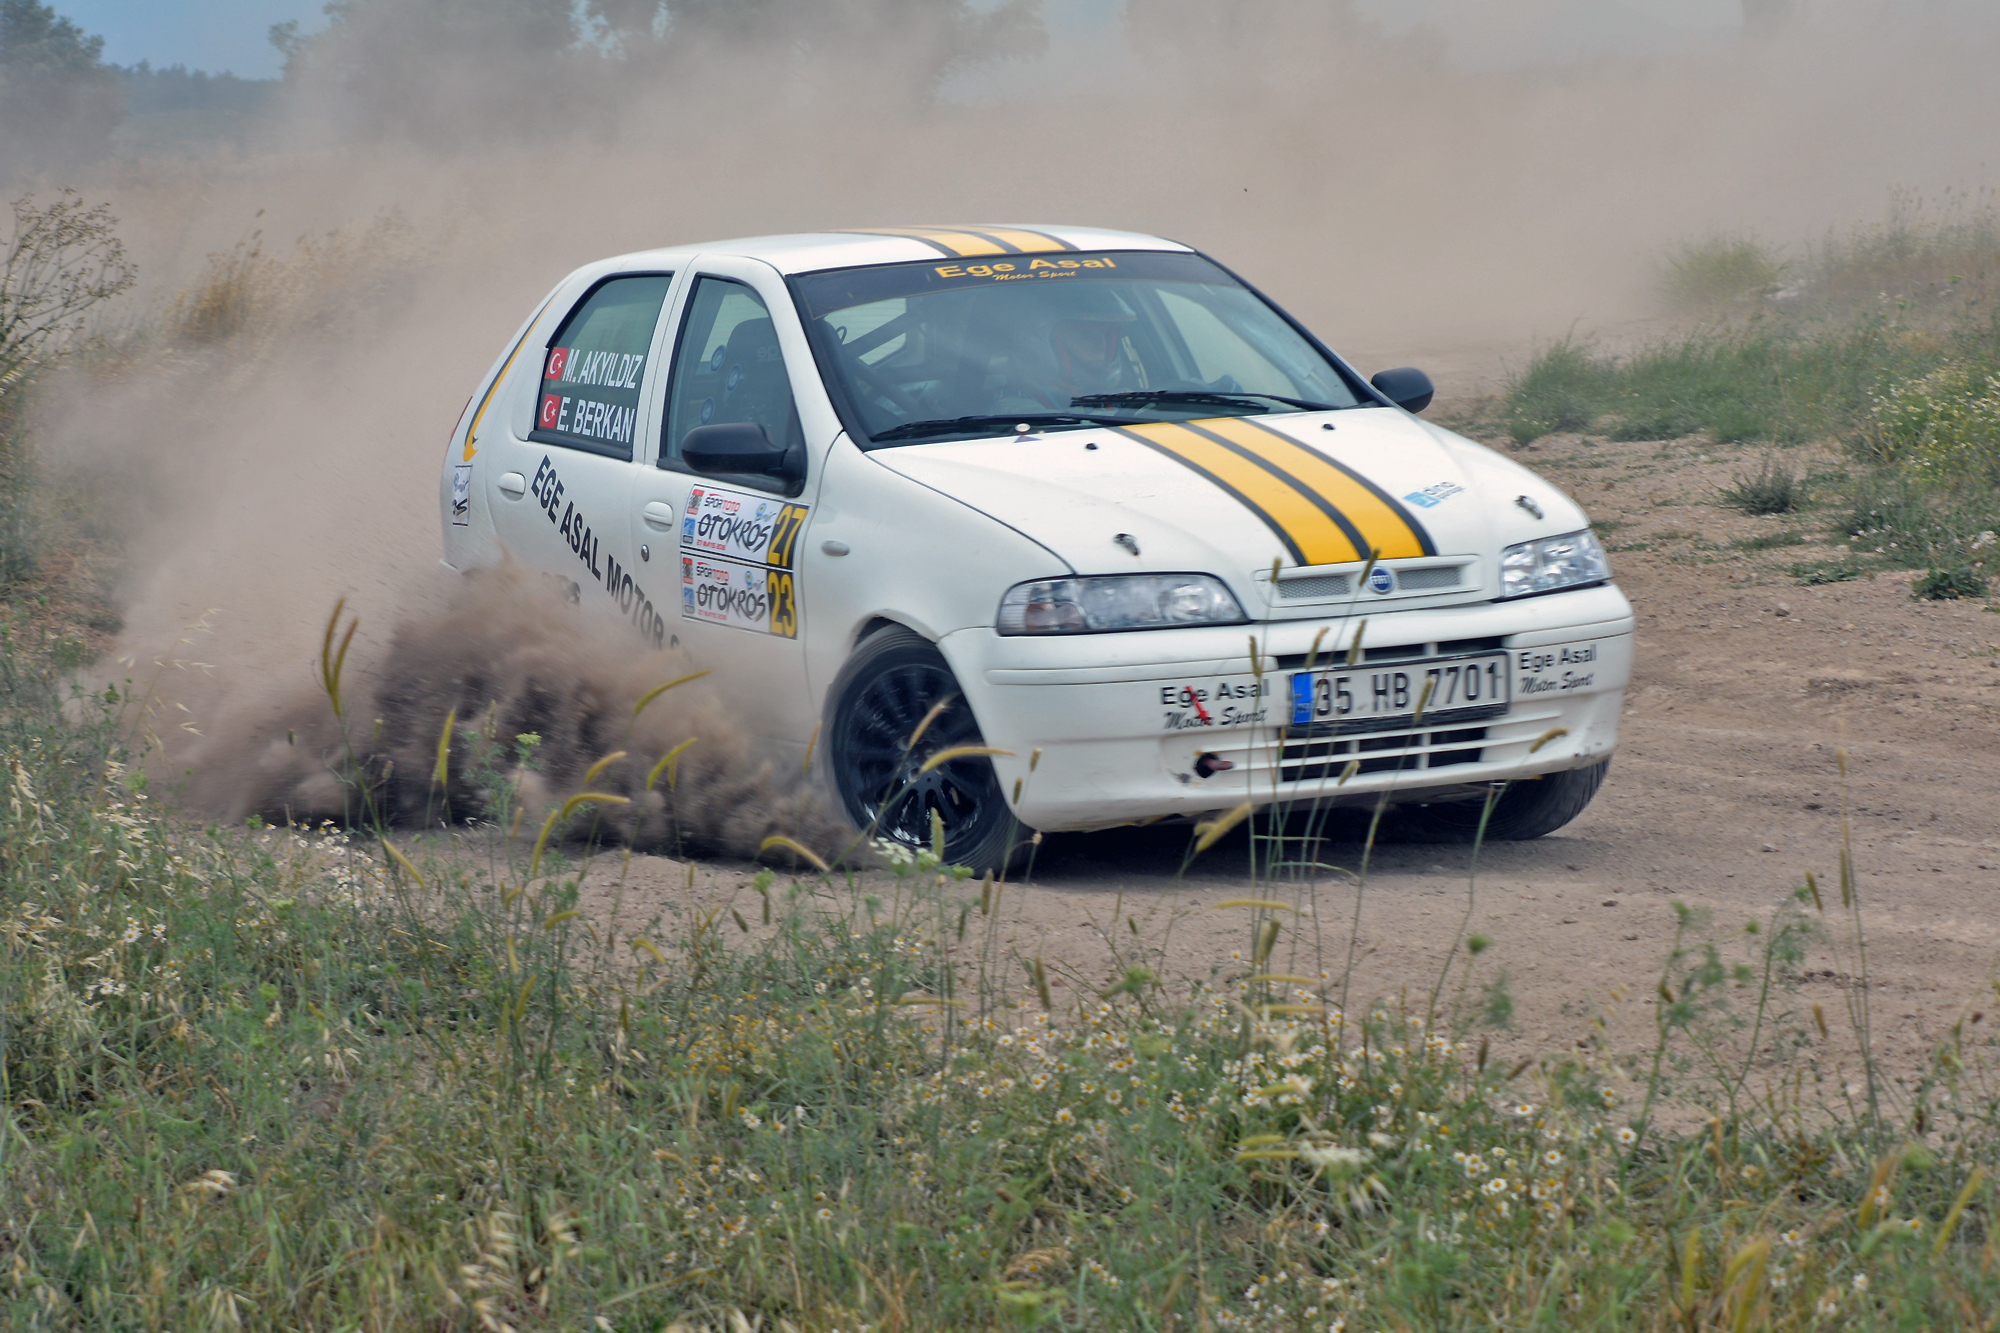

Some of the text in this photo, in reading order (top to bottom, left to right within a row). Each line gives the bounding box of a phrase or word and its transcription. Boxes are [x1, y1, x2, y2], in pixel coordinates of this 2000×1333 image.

[934, 257, 1117, 278] Ege Asal
[992, 270, 1077, 281] Motor Sport
[557, 396, 636, 443] E. BERKAN
[531, 454, 664, 650] EGE ASAL MOTOR
[698, 513, 772, 553] OTOKROS
[767, 504, 808, 567] 27
[696, 583, 766, 623] OTOKROS
[767, 571, 797, 638] 23
[1518, 644, 1597, 673] Ege Asal
[1161, 678, 1270, 709] Ege Asal
[1316, 661, 1498, 716] 35 HB 7701
[1559, 671, 1595, 693] Sport
